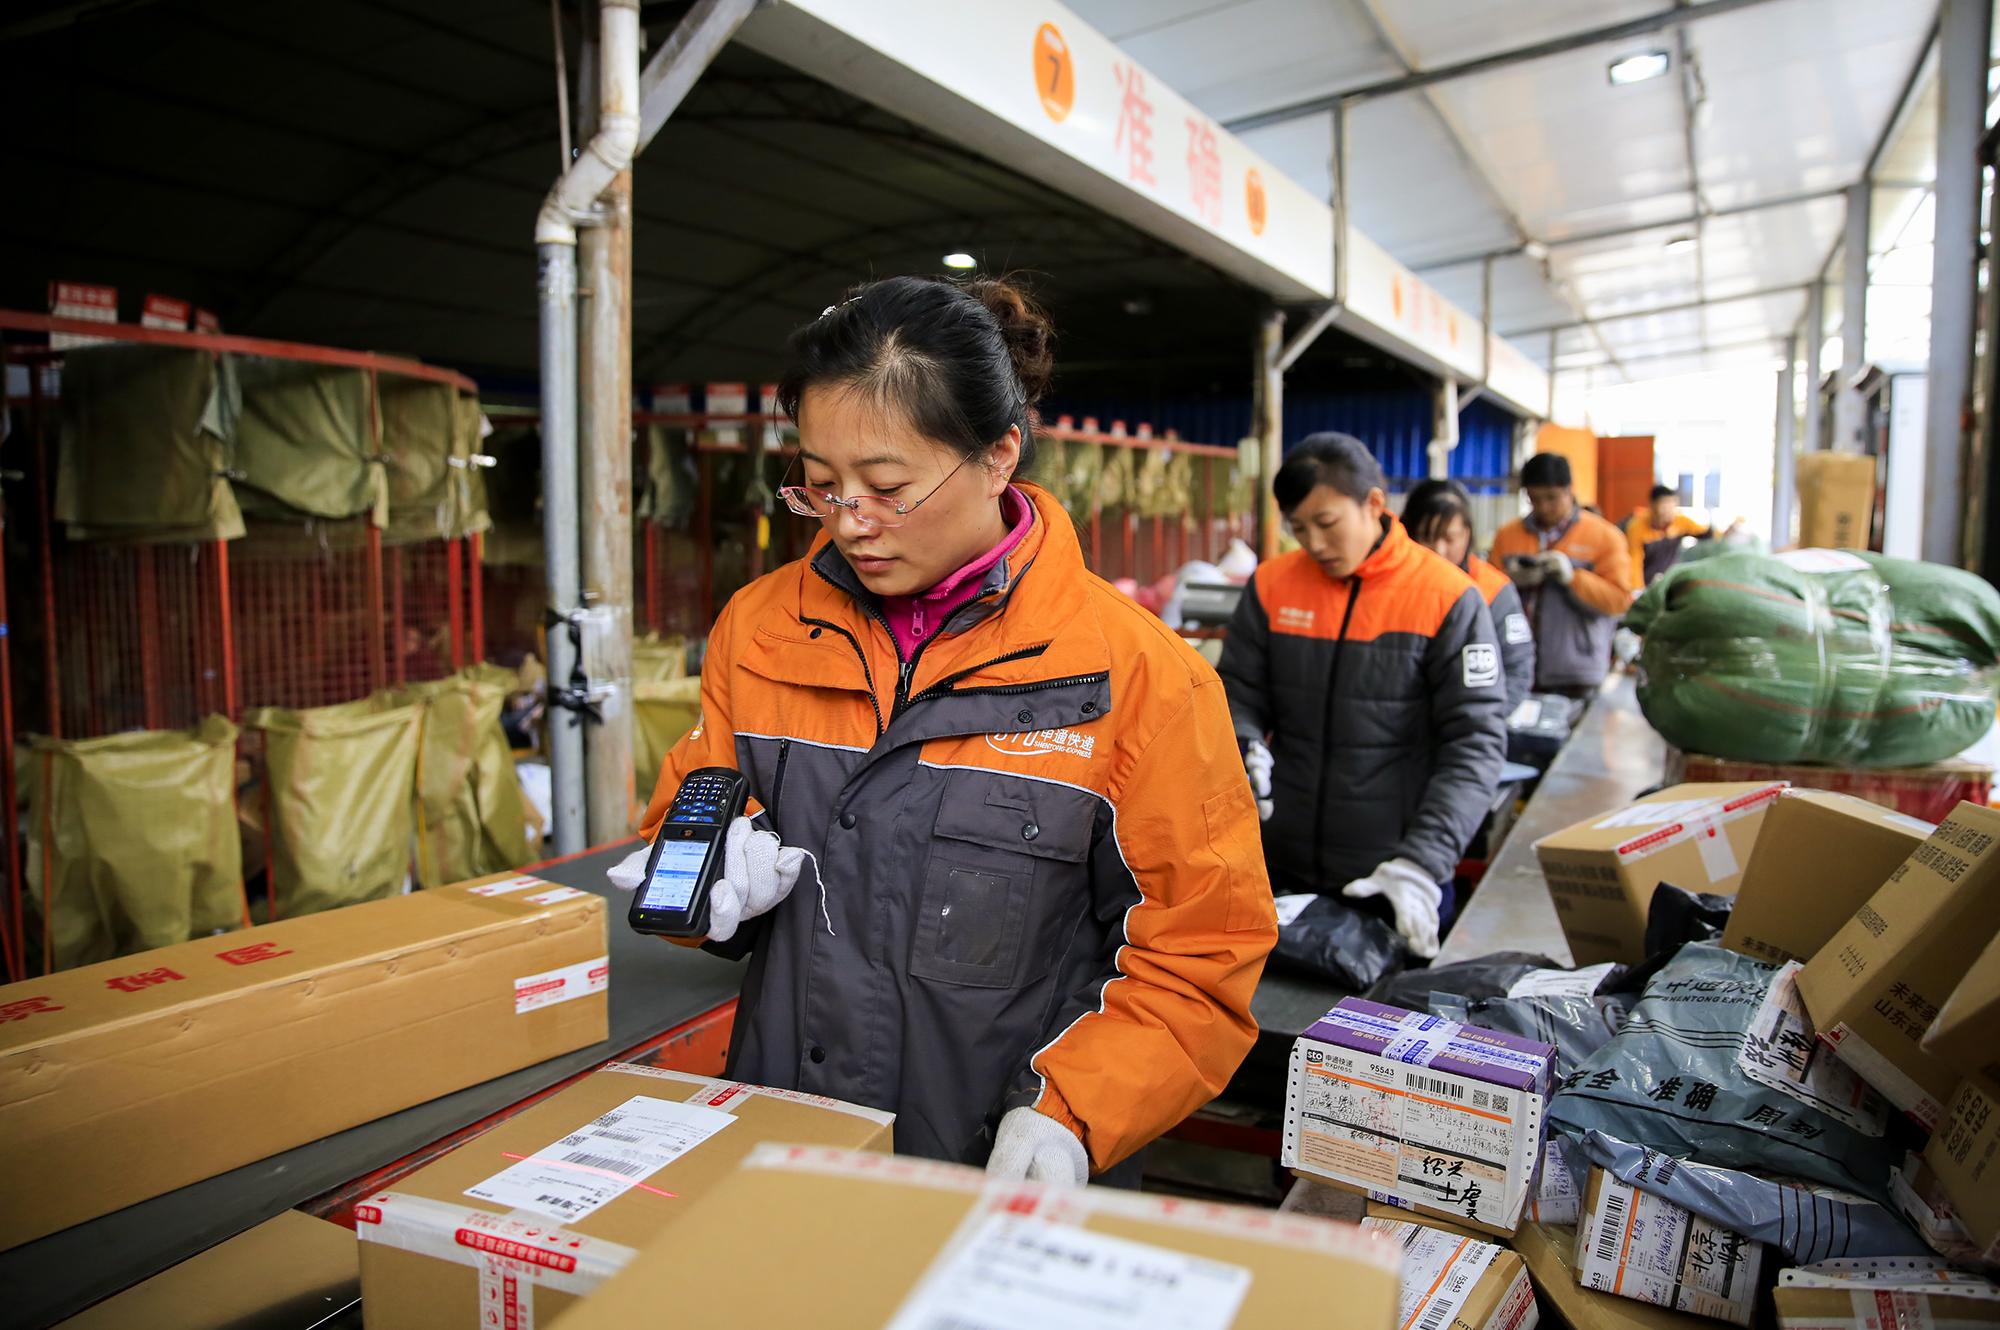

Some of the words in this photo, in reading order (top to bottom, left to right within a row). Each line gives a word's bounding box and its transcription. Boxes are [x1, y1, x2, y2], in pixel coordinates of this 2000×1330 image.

[1041, 728, 1095, 752] 申通快递
[1369, 1063, 1395, 1076] 95543
[1647, 1075, 1719, 1112] 准确
[1744, 1103, 1826, 1139] 周到
